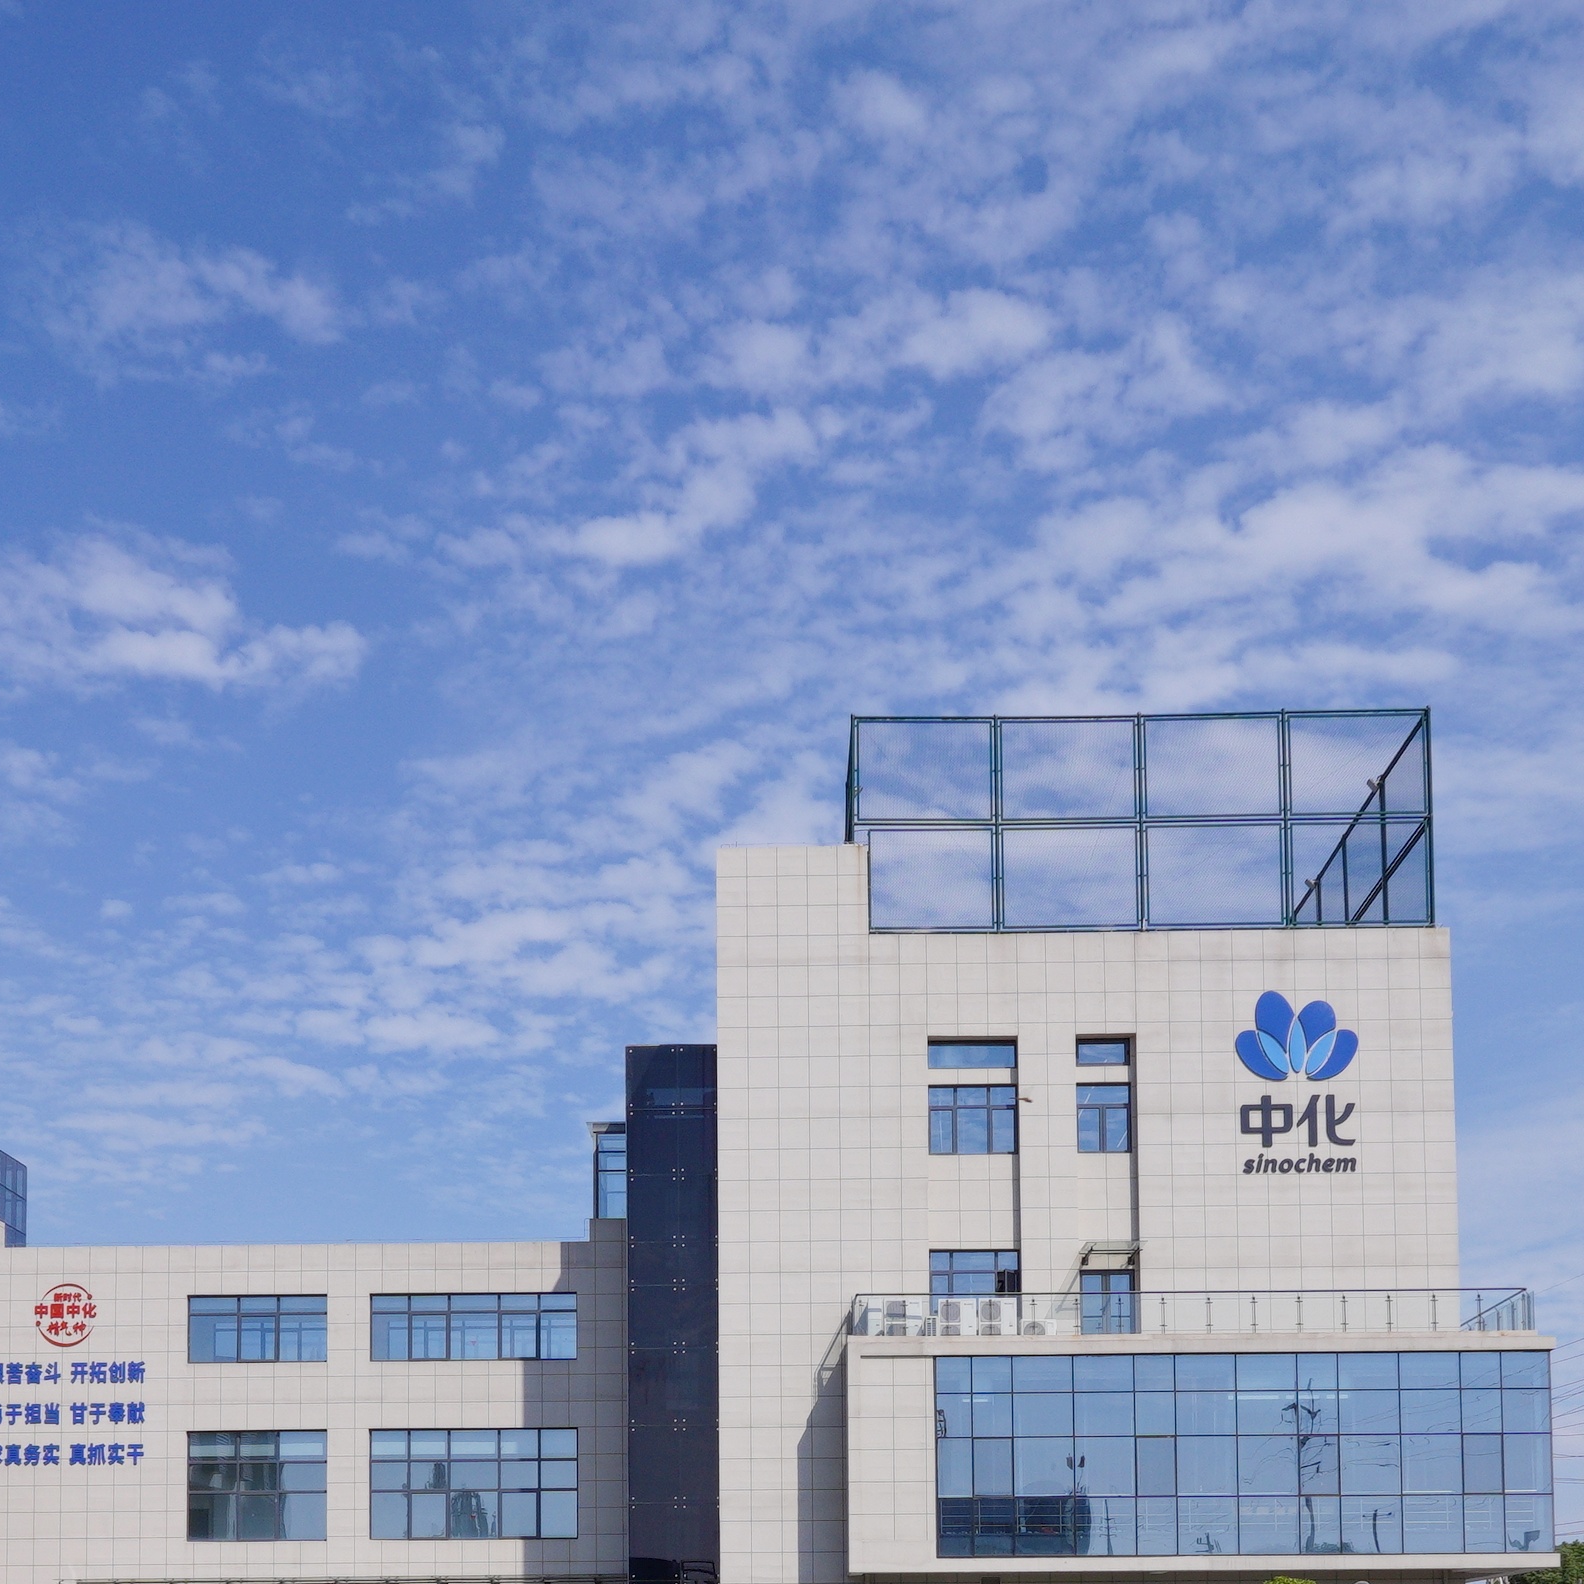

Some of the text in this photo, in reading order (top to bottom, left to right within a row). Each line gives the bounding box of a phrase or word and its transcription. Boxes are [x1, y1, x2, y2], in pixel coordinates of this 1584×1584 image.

[1240, 1094, 1356, 1148] 中化
[1242, 1153, 1357, 1175] sinochem
[53, 1292, 82, 1303] 新时代
[34, 1302, 97, 1319] 中国中化
[71, 1361, 146, 1384] 开拓创新
[70, 1401, 146, 1425] 甘于奉献
[69, 1442, 145, 1466] 真抓实干
